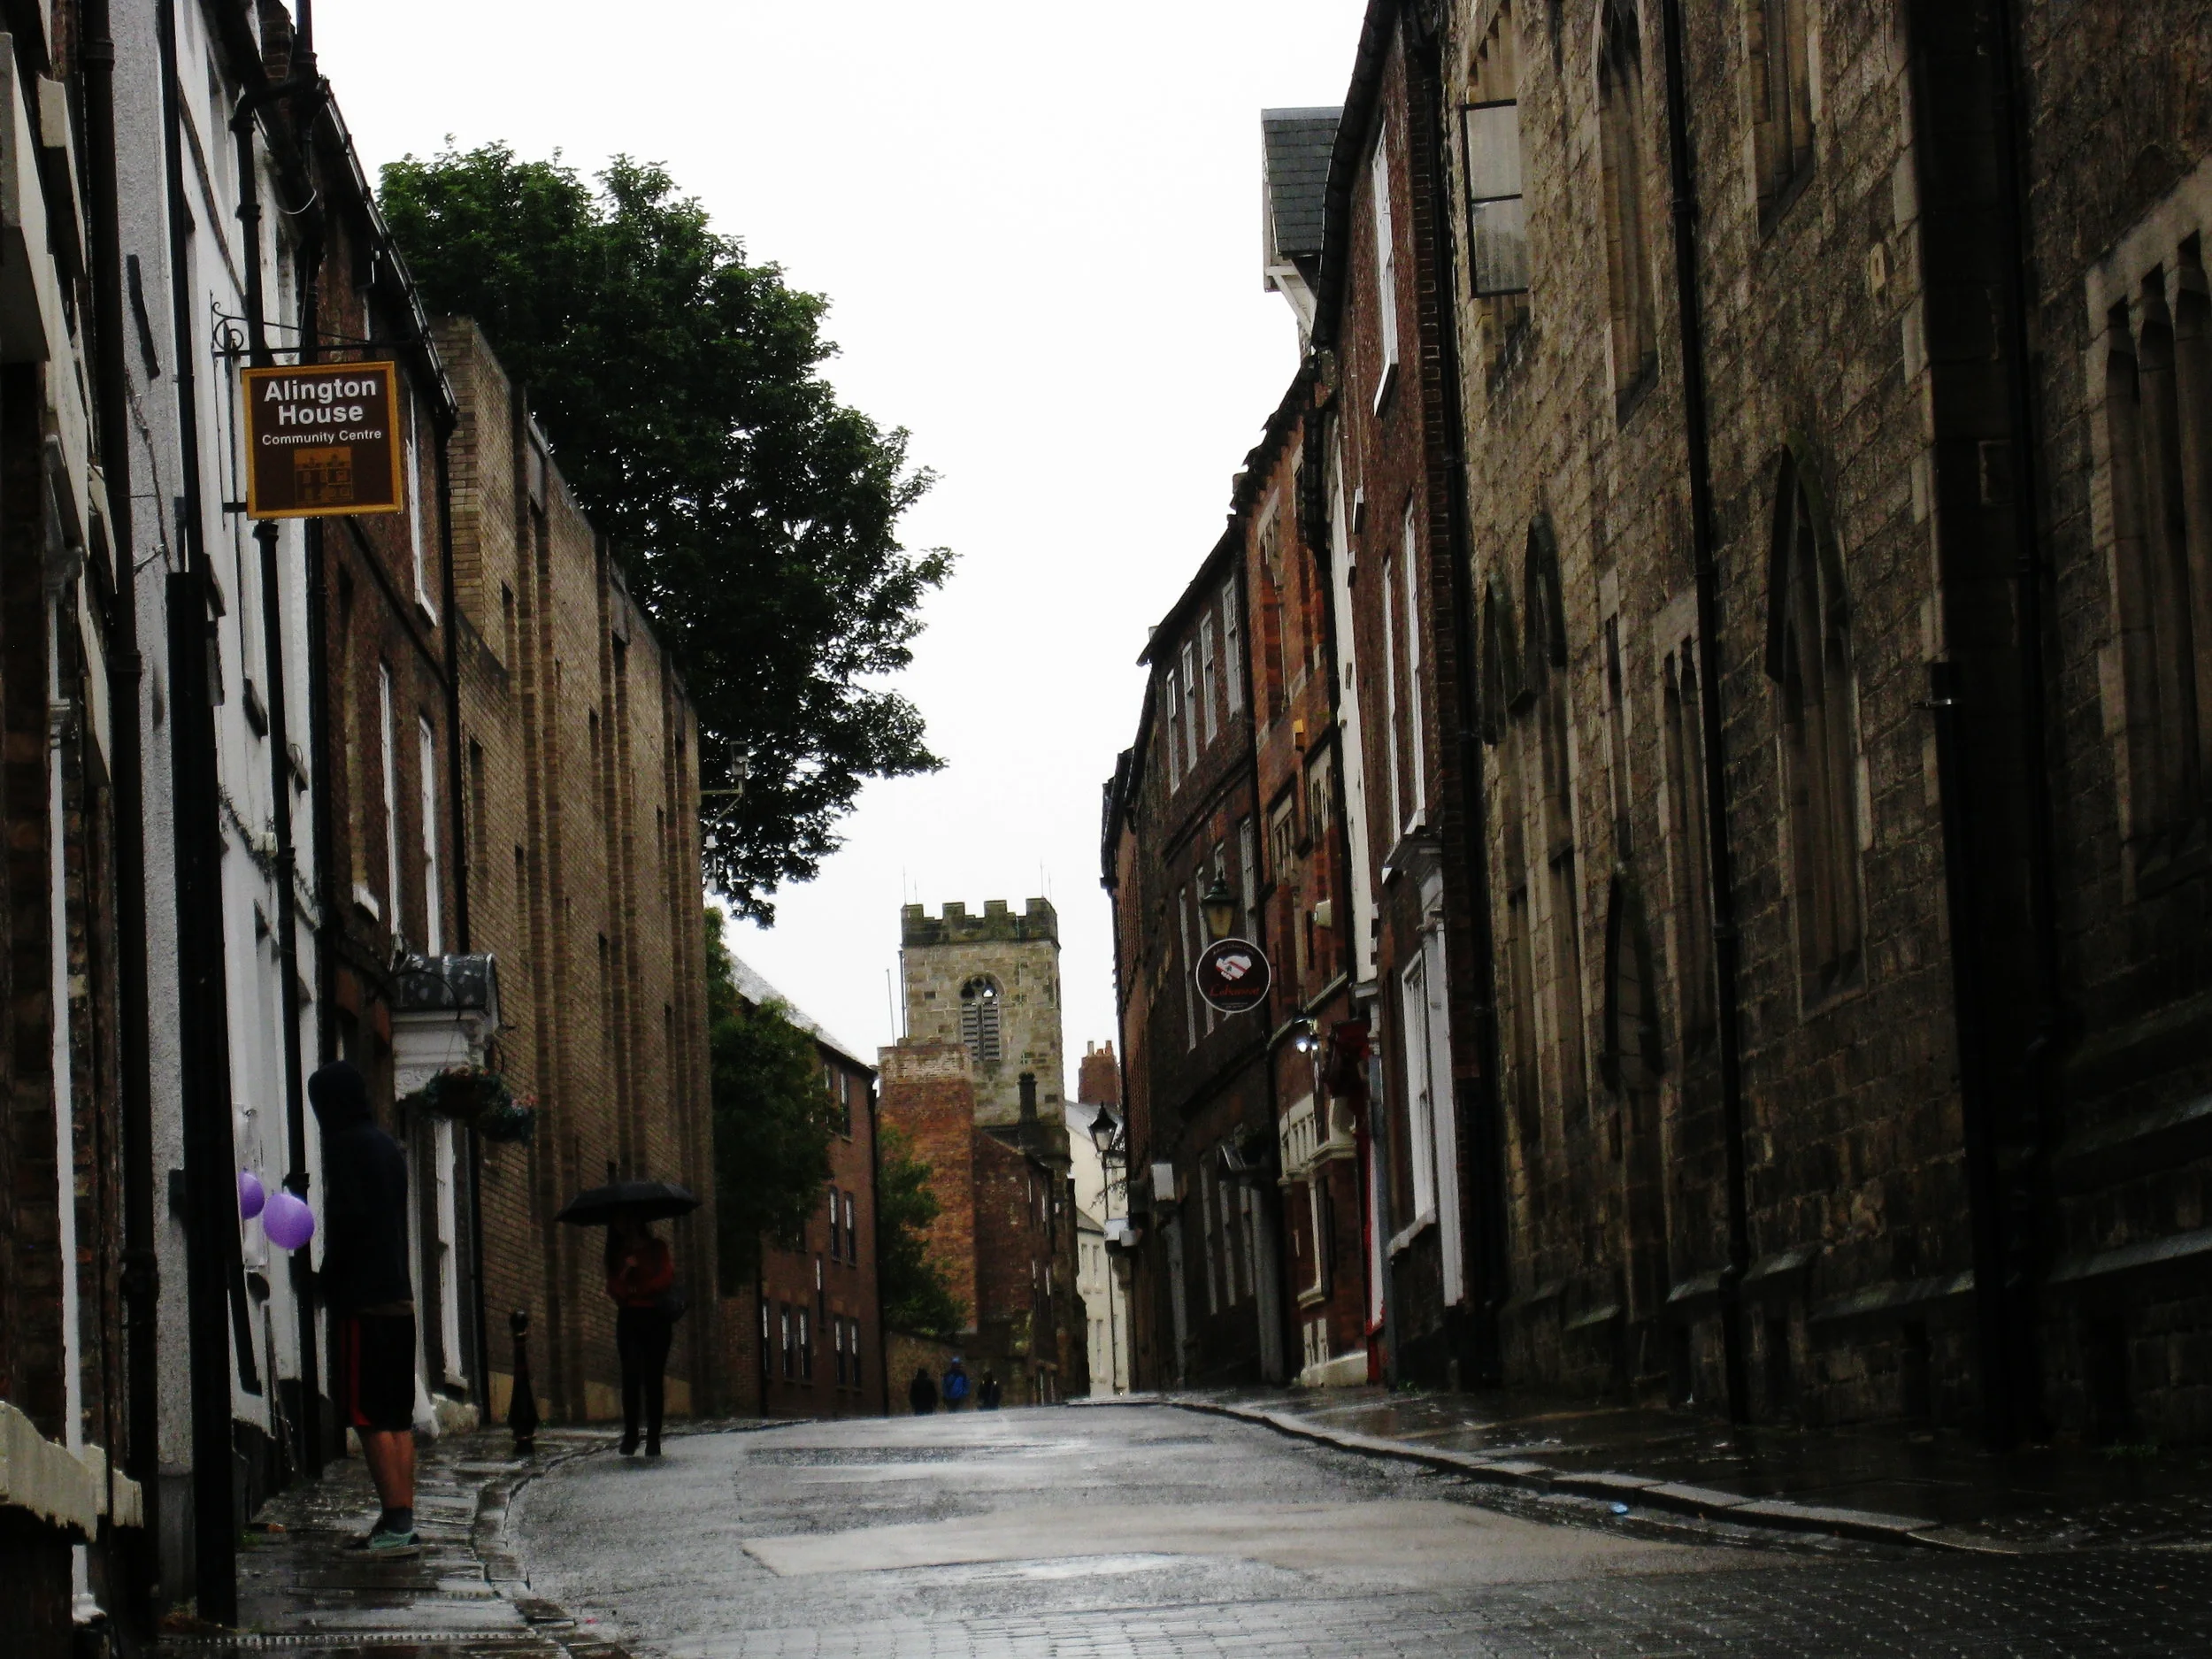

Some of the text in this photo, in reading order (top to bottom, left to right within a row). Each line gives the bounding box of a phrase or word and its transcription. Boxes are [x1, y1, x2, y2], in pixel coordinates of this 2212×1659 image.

[264, 379, 377, 403] Alington
[278, 405, 363, 425] House
[262, 430, 382, 445] Community Centre
